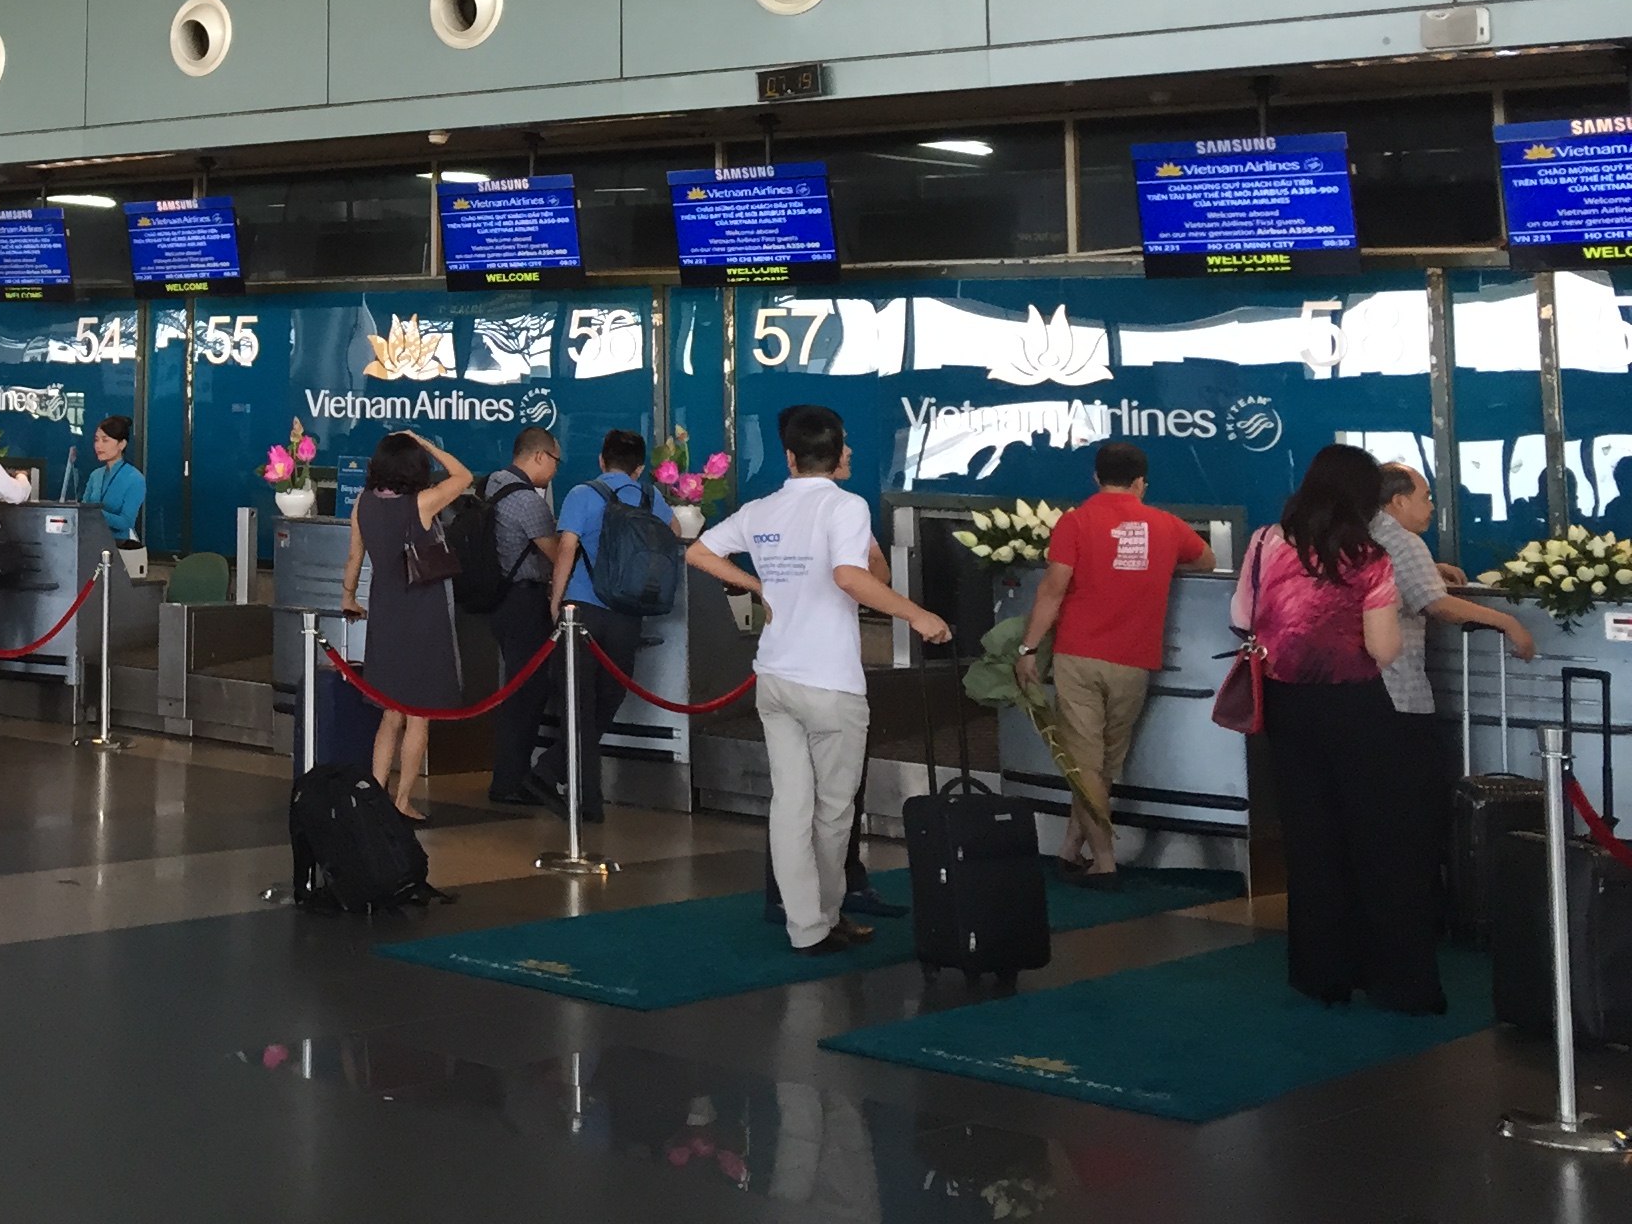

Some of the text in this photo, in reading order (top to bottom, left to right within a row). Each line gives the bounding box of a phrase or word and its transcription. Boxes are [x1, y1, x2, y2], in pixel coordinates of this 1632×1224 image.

[1196, 136, 1276, 155] SAMSUNG
[715, 165, 775, 181] SAMSUNG
[478, 178, 529, 192] SAMSUNG
[157, 199, 198, 211] SAMSUNG
[486, 272, 540, 283] WELCOME
[165, 282, 208, 291] WELCOME
[75, 317, 121, 364] 54
[204, 315, 259, 364] 55
[752, 308, 829, 366] 57
[1226, 395, 1272, 442] SKYTEAM
